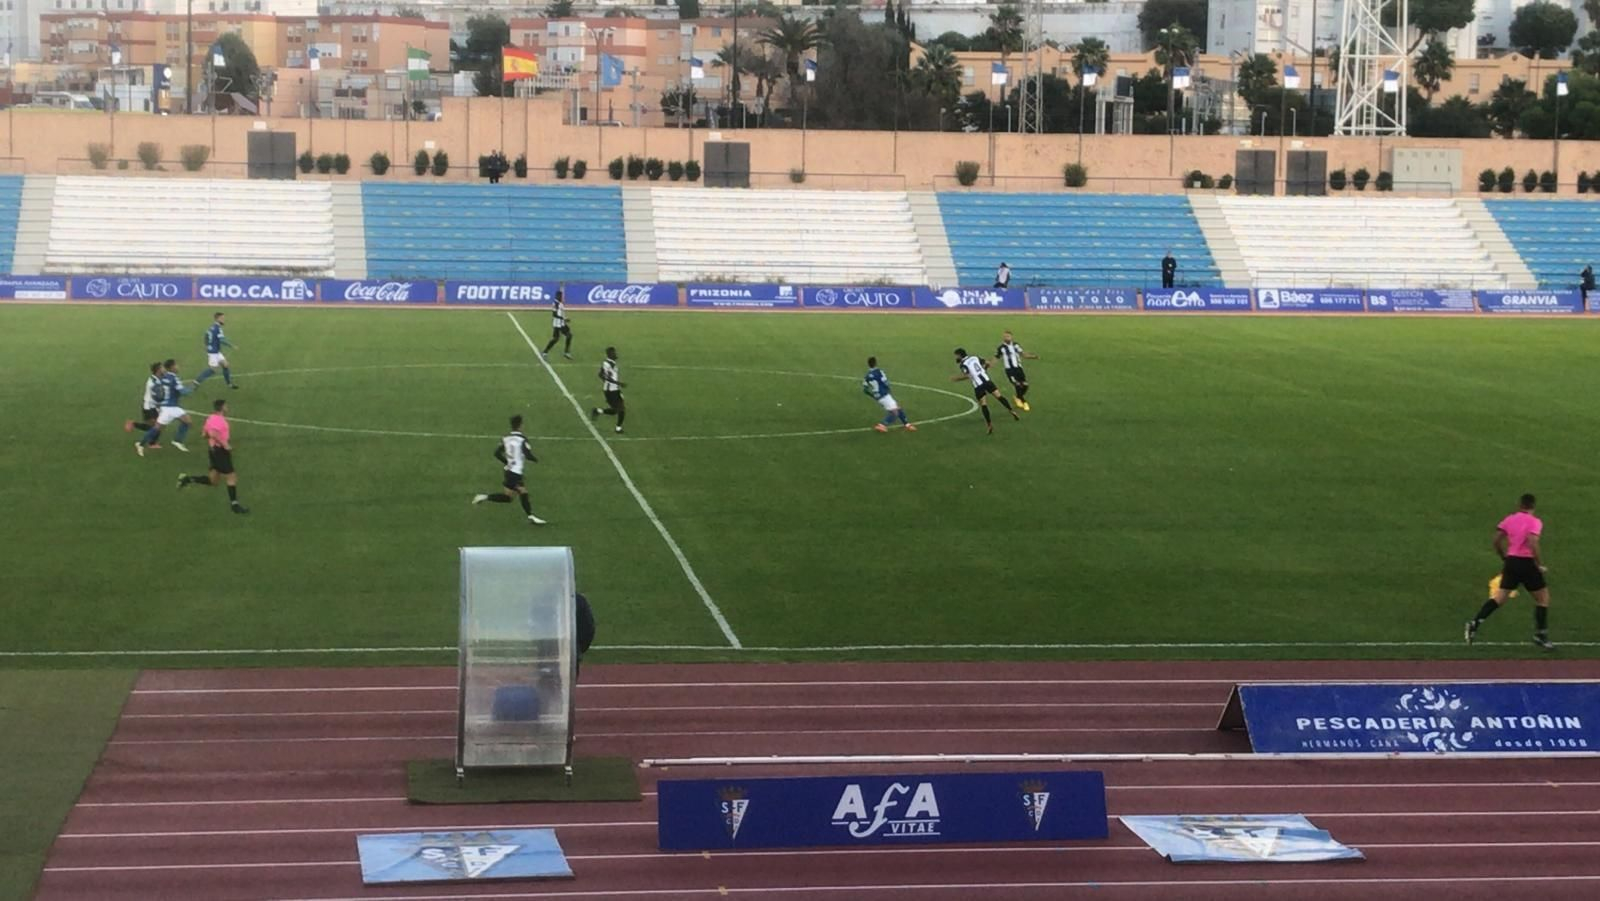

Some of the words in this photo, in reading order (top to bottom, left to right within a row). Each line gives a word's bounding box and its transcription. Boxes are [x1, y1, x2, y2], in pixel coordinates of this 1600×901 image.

[117, 283, 178, 298] CAUTO
[344, 282, 412, 301] Coca-Cola
[587, 284, 653, 304] Coca-Cola
[690, 289, 751, 298] FRIZONIA
[844, 293, 900, 306] CAUTO
[1041, 296, 1125, 304] BARTOLO
[1280, 291, 1314, 304] Báez
[1370, 295, 1387, 305] BS
[1502, 295, 1558, 305] GRANVIA
[1296, 716, 1454, 730] PESCADERIA
[1471, 714, 1582, 729] ANTOÑIN
[1495, 739, 1543, 747] desde
[1550, 739, 1588, 747] 1968
[890, 821, 935, 834] VITAE
